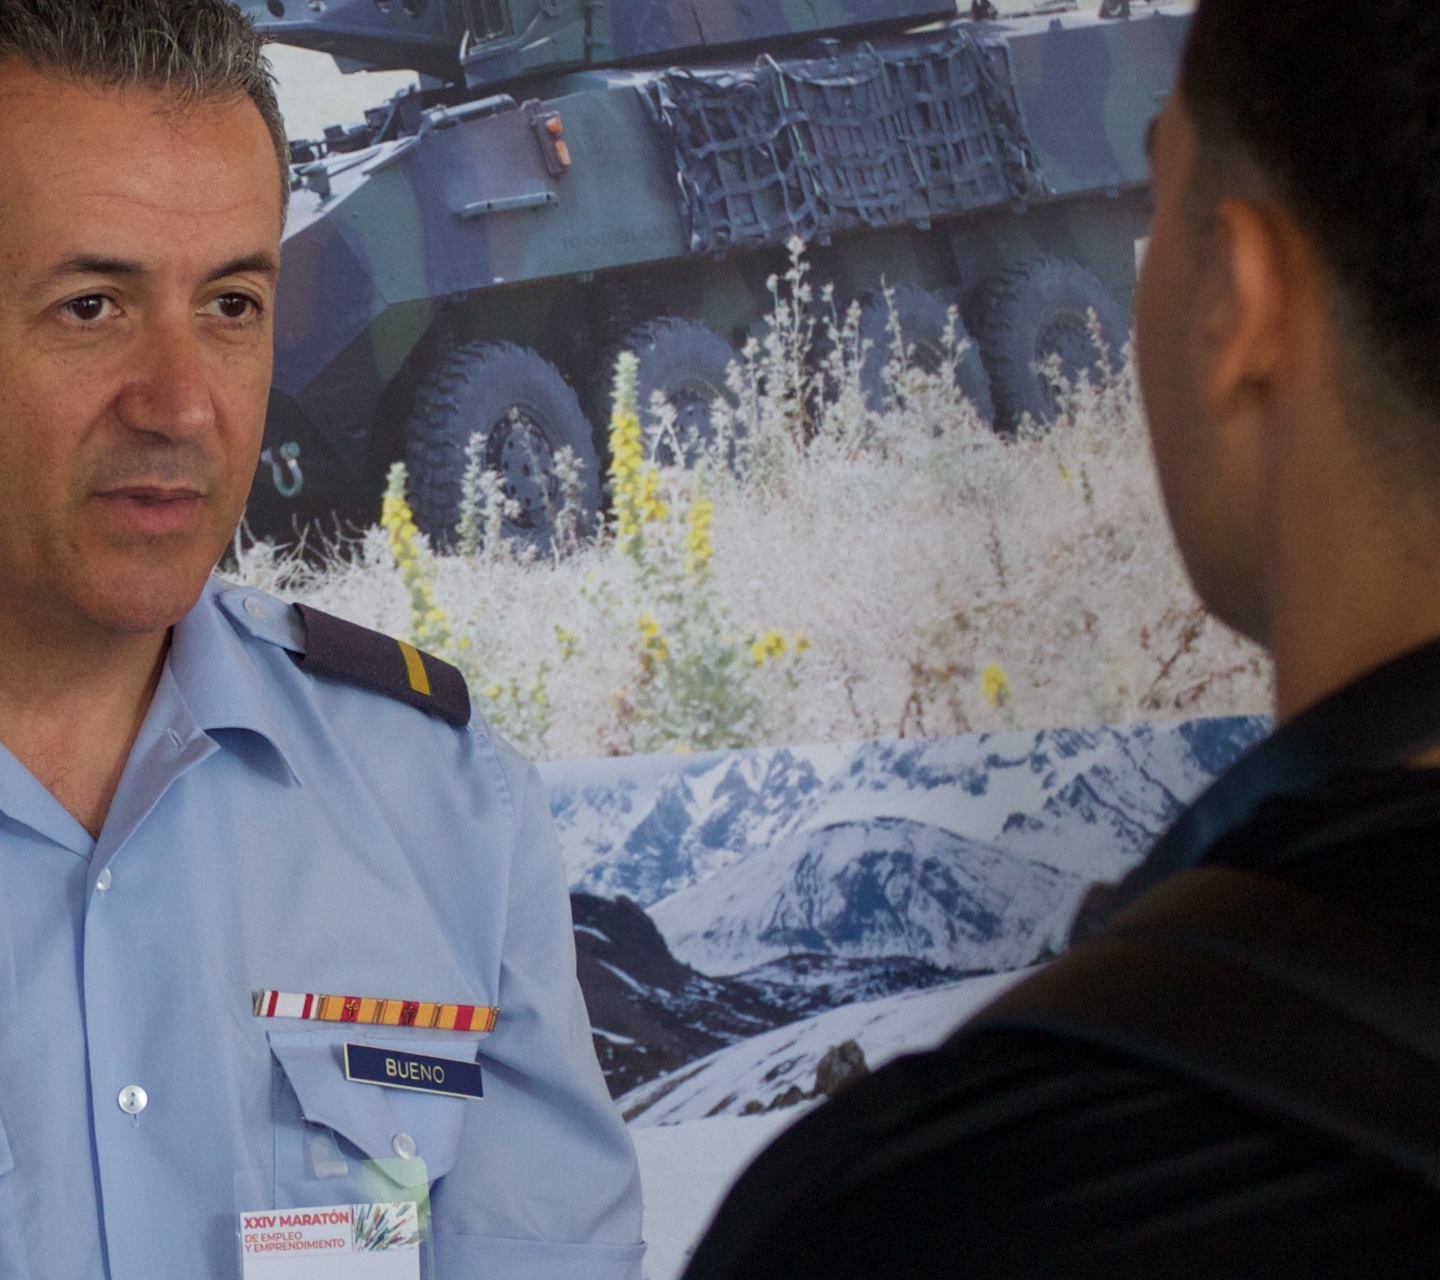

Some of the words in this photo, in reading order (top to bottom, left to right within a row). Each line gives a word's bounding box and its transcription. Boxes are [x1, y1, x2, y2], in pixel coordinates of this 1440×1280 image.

[386, 1058, 445, 1084] BUENO
[244, 1216, 276, 1229] XXIV
[279, 1209, 349, 1227] MARATÓN
[244, 1233, 259, 1243] DE
[261, 1231, 303, 1242] EMPLEO
[245, 1245, 251, 1253] Y
[254, 1238, 345, 1252] EMPRENDIMIENTO
